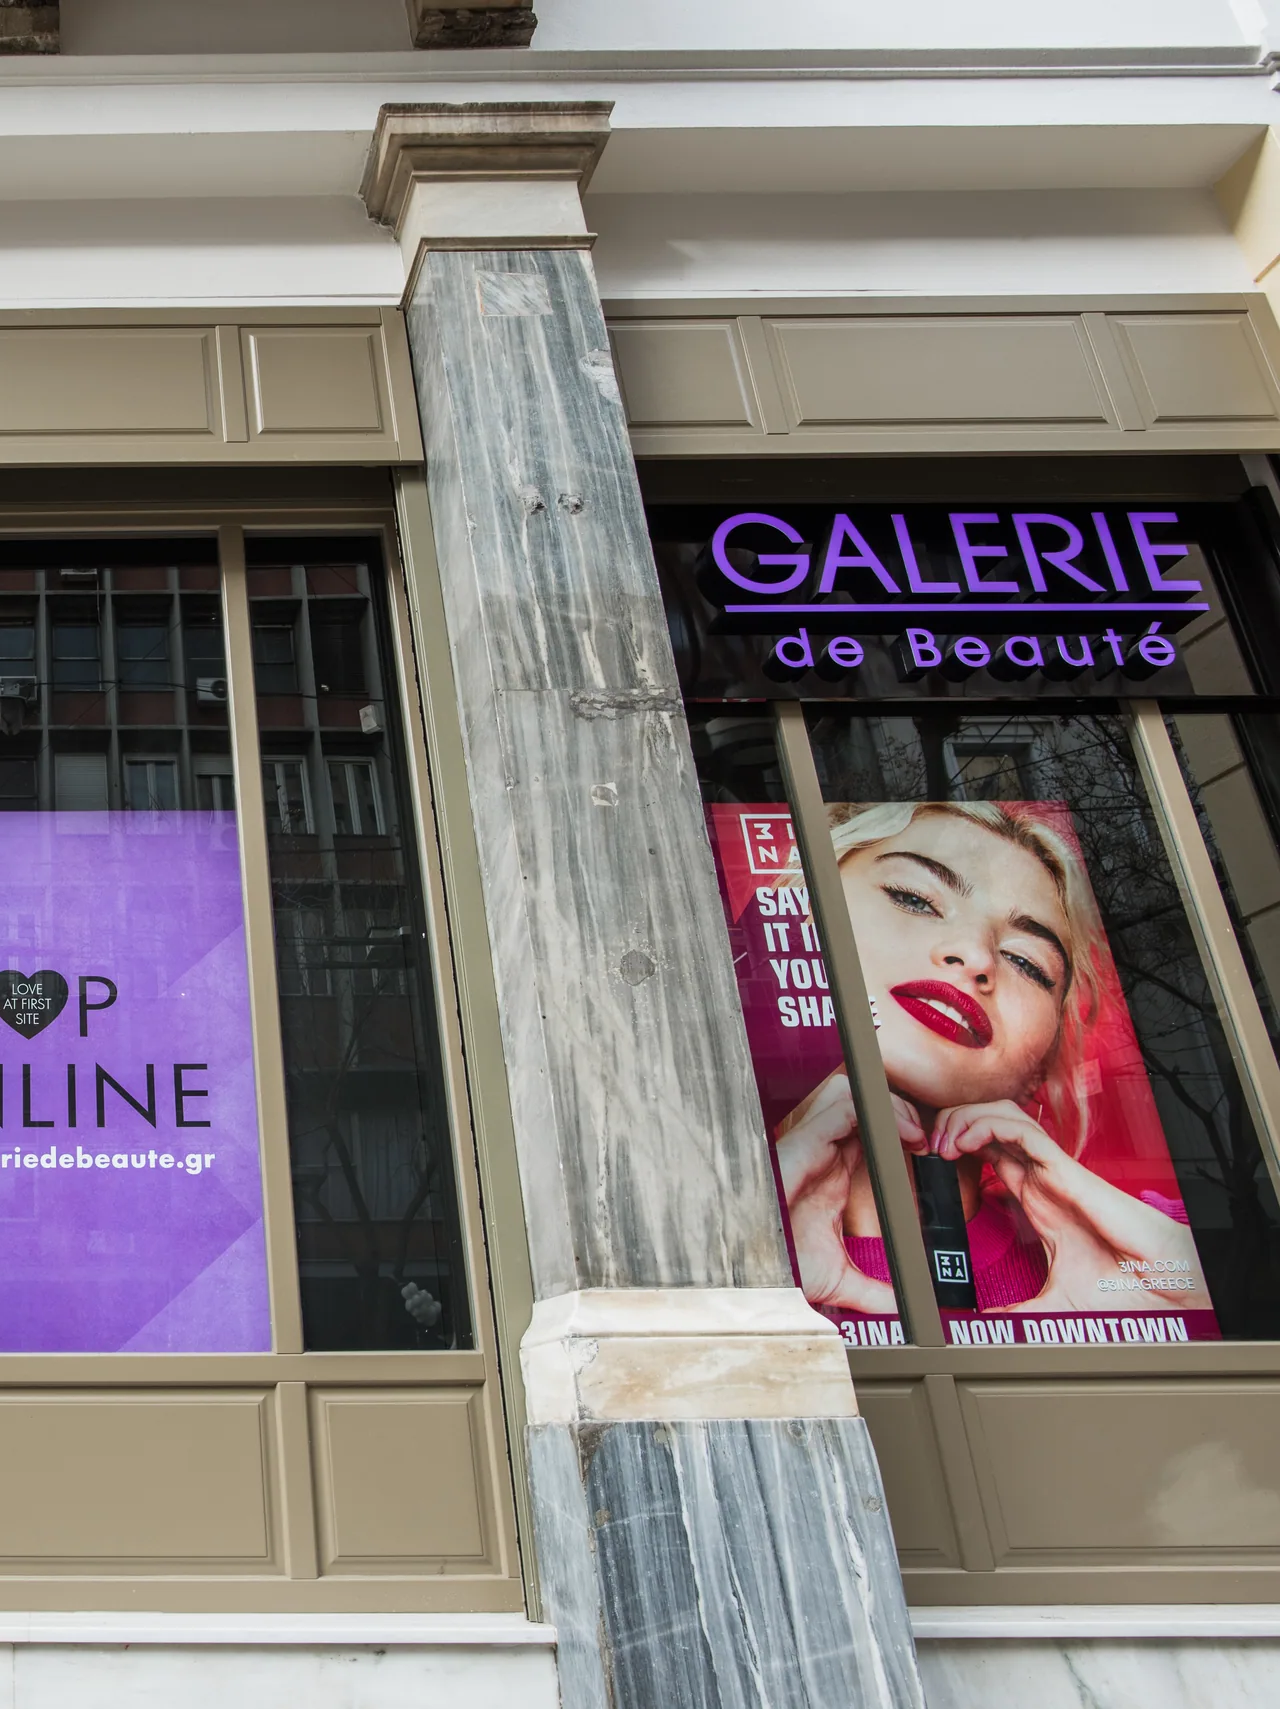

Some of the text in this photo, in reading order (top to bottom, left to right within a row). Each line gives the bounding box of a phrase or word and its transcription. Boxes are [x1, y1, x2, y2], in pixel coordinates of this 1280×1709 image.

[712, 512, 1203, 595] GALERIE
[775, 621, 1177, 669] de Beauté
[756, 887, 810, 916] SAY
[763, 922, 790, 952] IT
[11, 983, 43, 995] LOVE
[3, 998, 52, 1010] AT FIRST
[15, 1013, 40, 1025] SITE
[1118, 1260, 1191, 1273] 3INA.COM
[1097, 1277, 1196, 1291] @3INAGREECE
[840, 1316, 1189, 1346] 3INA NOW DOWNTOWN
